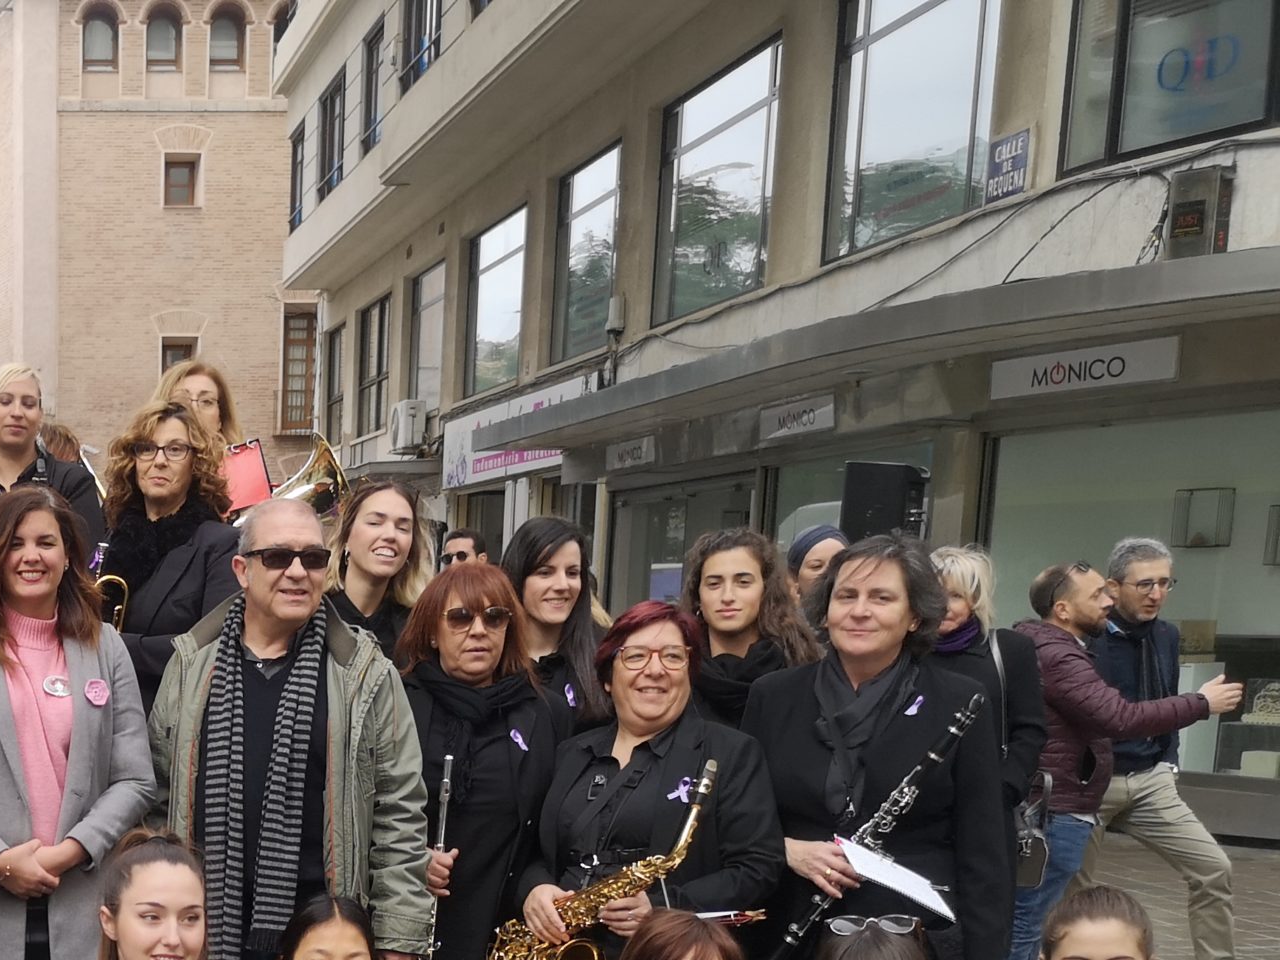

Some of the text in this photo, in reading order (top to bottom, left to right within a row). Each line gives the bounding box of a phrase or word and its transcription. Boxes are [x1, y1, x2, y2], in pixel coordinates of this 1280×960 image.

[995, 137, 1024, 163] CALLE
[1002, 160, 1013, 173] DE
[987, 168, 1024, 198] REQUENA
